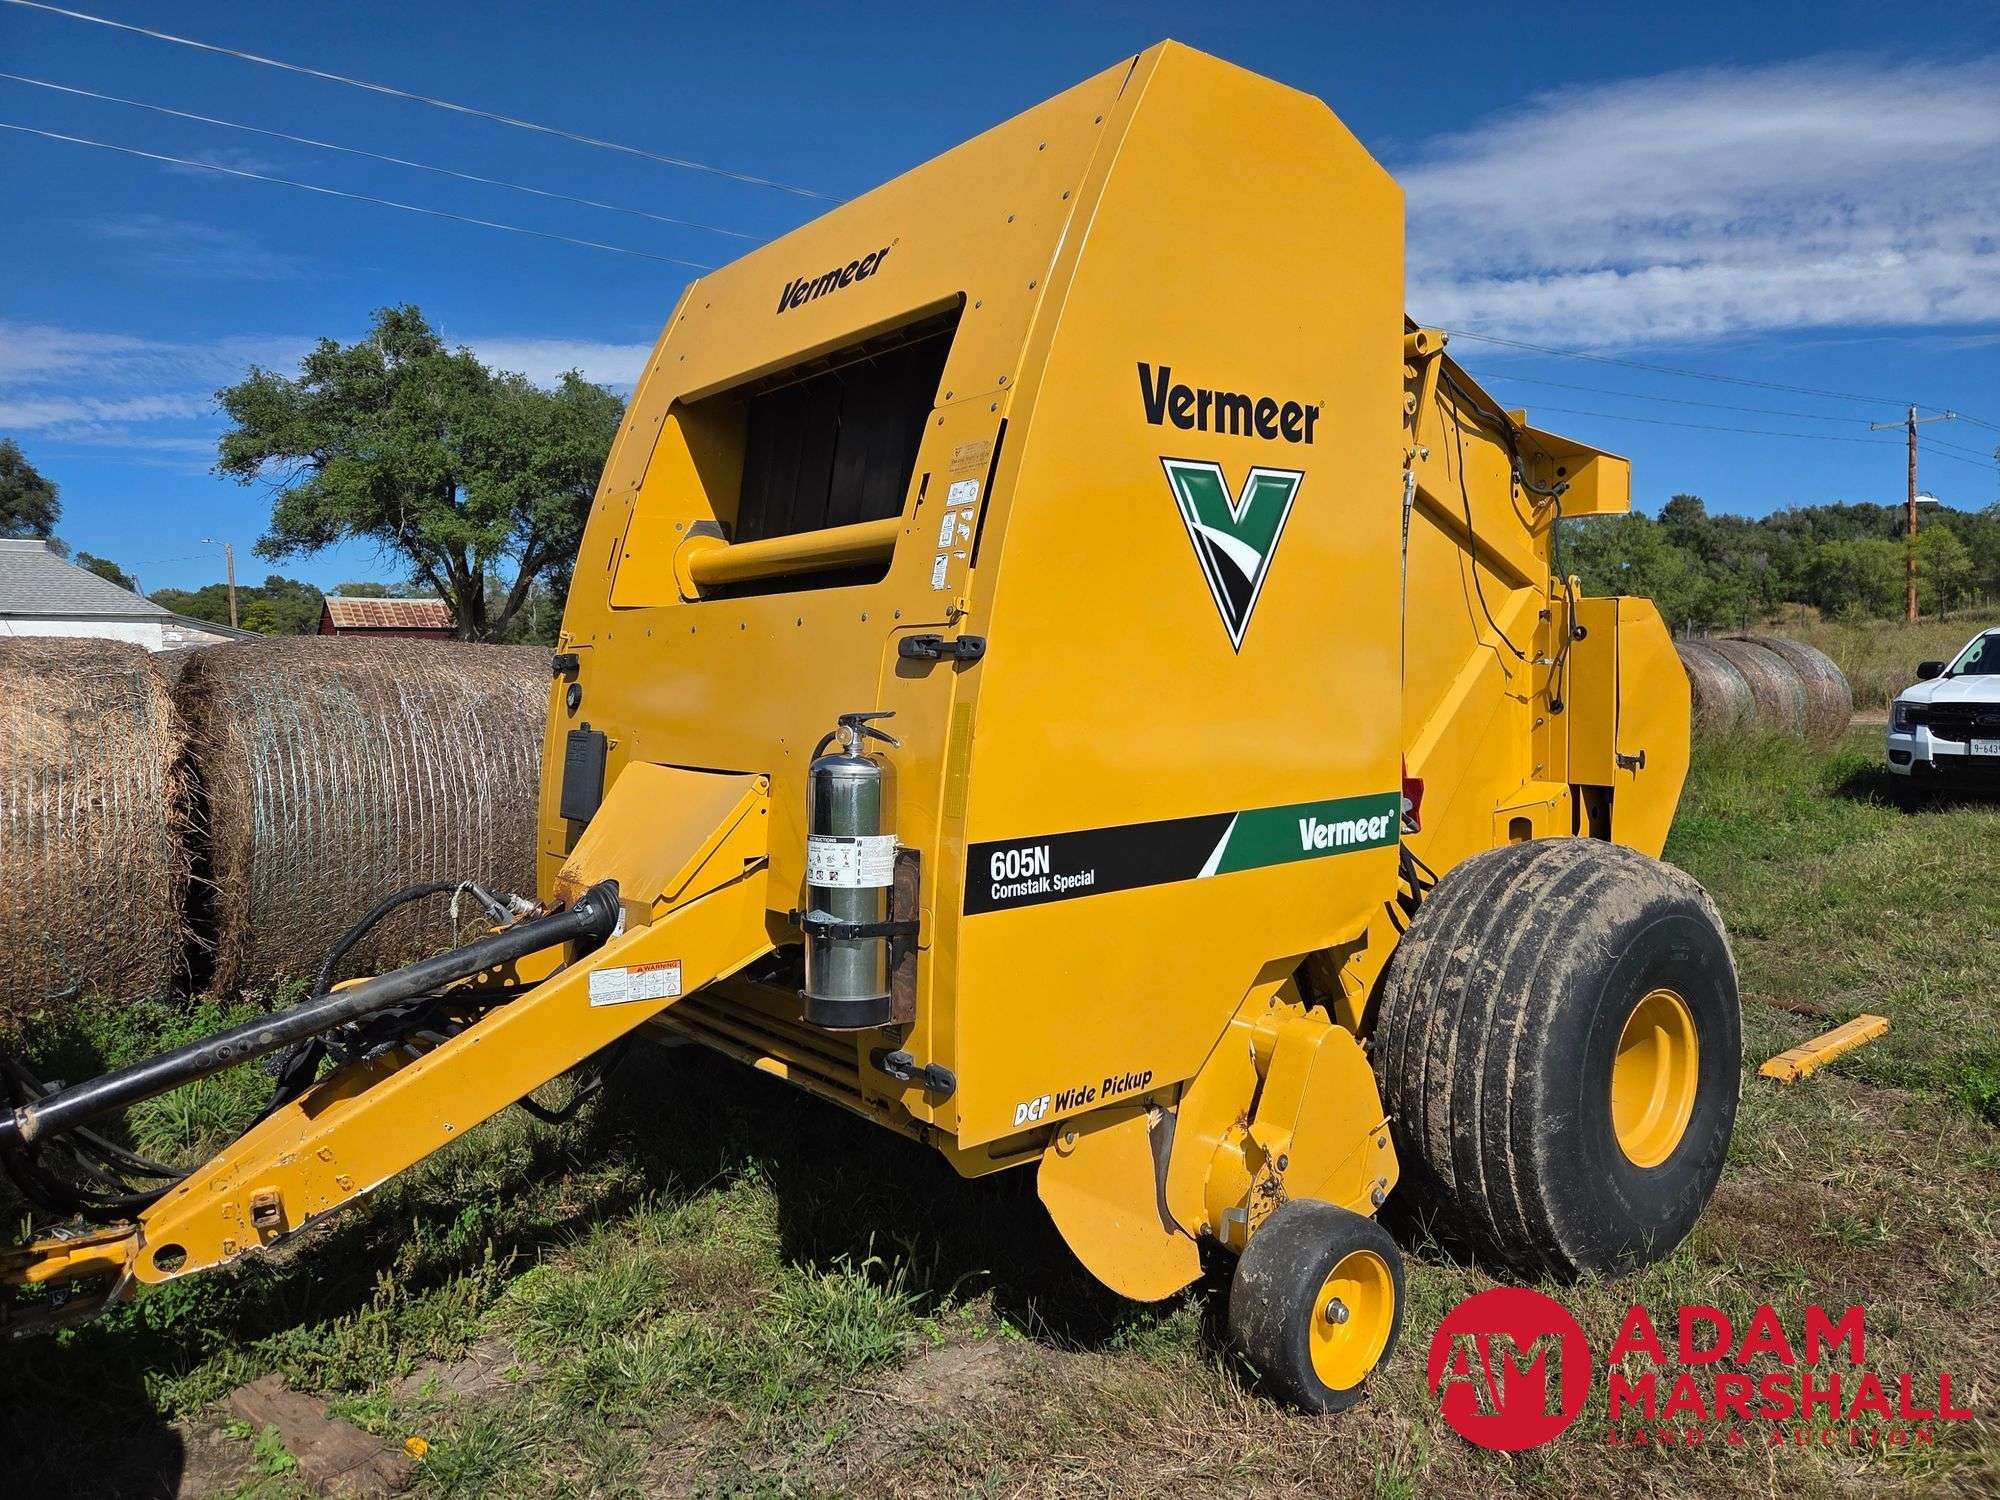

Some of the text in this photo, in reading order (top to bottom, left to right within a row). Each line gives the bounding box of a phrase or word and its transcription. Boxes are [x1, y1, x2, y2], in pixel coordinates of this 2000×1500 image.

[776, 246, 891, 315] Vermeer
[1136, 361, 1320, 445] Vermeer
[1974, 744, 2000, 753] 9-643
[990, 845, 1050, 881] 605N
[991, 869, 1095, 900] Cornstalk Special
[644, 960, 679, 972] WARNING
[1013, 1070, 1153, 1128] DCF Wide Pickup
